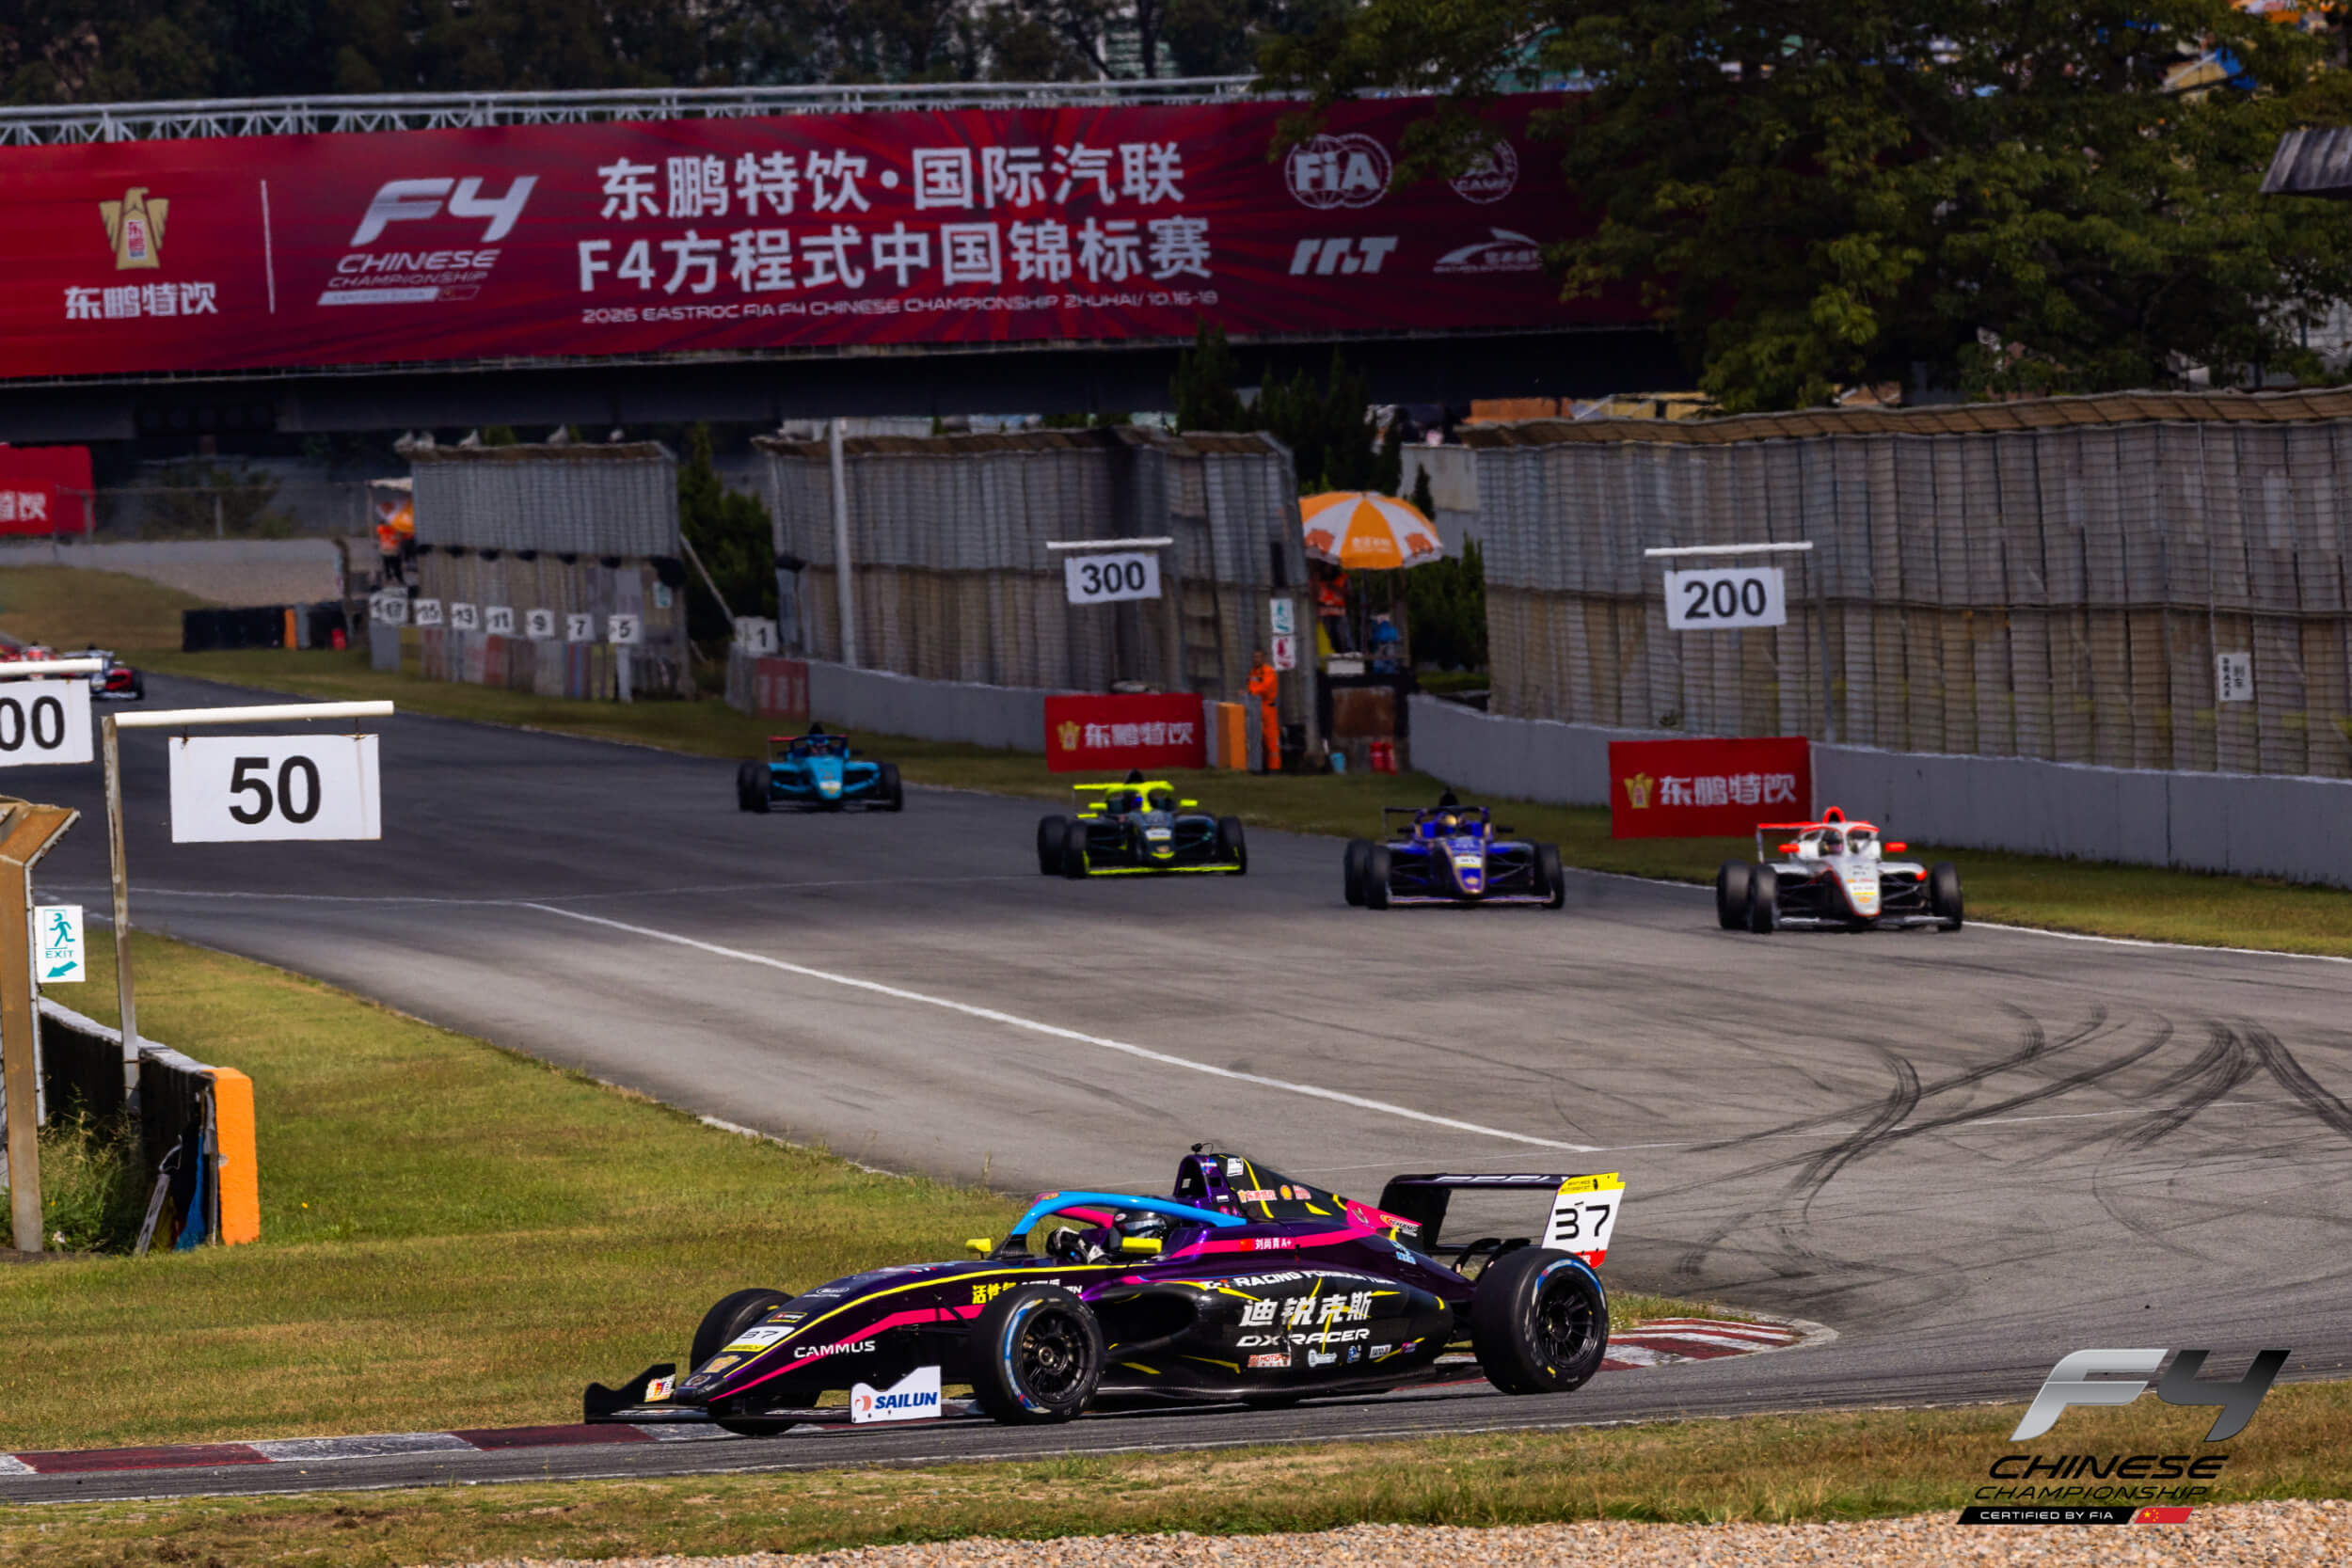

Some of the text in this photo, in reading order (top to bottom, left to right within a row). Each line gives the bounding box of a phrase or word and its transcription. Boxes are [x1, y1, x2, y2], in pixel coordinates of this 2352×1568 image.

[350, 175, 540, 247] F4
[337, 248, 501, 274] CHINESE
[578, 214, 1213, 294] F4方程式中国锦标赛
[327, 271, 488, 288] CHAMPIONSHIP
[64, 282, 218, 320] 东鹏特饮
[642, 304, 739, 322] EASTROC
[743, 303, 775, 318] FIA
[778, 301, 807, 316] F4
[809, 298, 900, 316] CHINESE
[904, 294, 1059, 312] CHAMPIONSHIP
[1081, 561, 1146, 594] 300
[1683, 578, 1767, 620] 200
[575, 619, 586, 636] 7
[619, 619, 630, 639] 5
[756, 626, 767, 648] 1
[1085, 721, 1194, 749] 东鹏特饮
[229, 755, 321, 825] 50
[1659, 772, 1797, 807] 东鹏特饮
[45, 949, 73, 959] EXIT
[1555, 1204, 1611, 1241] 37
[1233, 1271, 1303, 1287] RACING
[972, 1282, 1016, 1305] 活性
[1238, 1291, 1373, 1326] 迪锐克斯
[794, 1340, 876, 1358] CAMMUS
[875, 1392, 937, 1410] SAILUN
